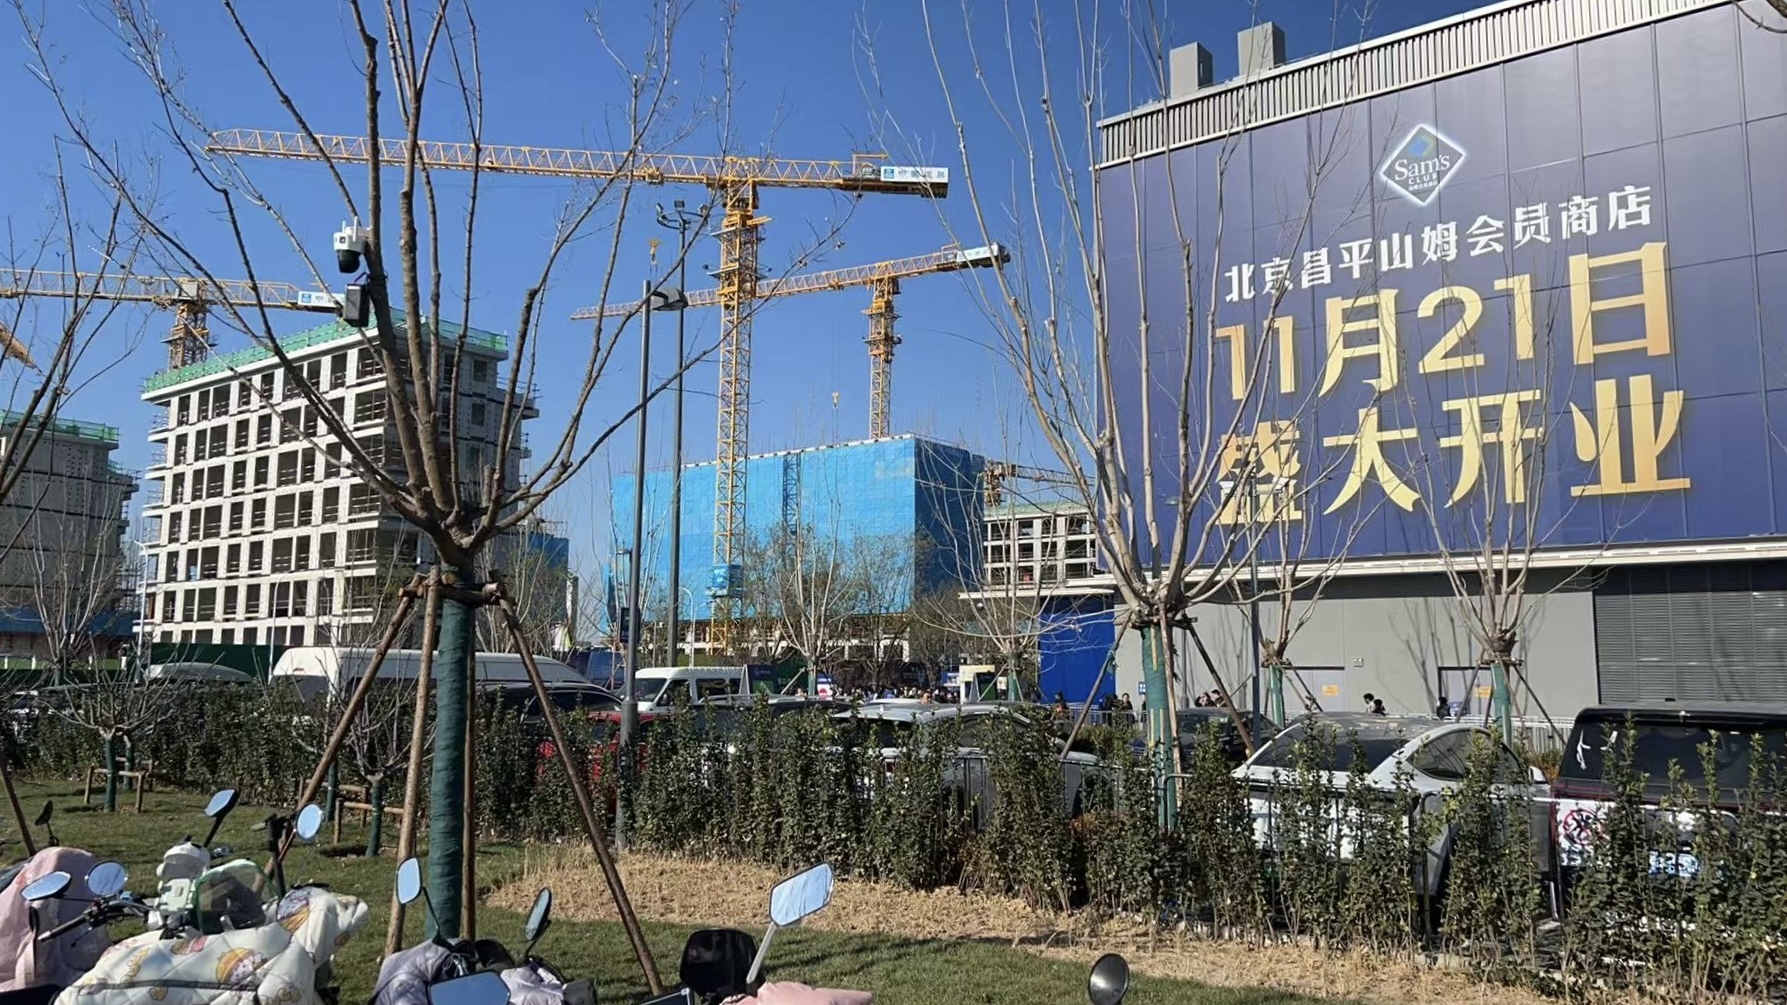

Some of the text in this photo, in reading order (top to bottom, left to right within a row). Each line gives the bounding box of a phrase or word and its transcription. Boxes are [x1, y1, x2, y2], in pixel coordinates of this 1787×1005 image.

[1394, 155, 1450, 181] Sam's
[1408, 172, 1438, 185] CLUB
[1225, 185, 1651, 303] 北京昌平山姆会员商店
[1216, 242, 1668, 400] 11月21日
[1215, 374, 1691, 525] 盛大开业
